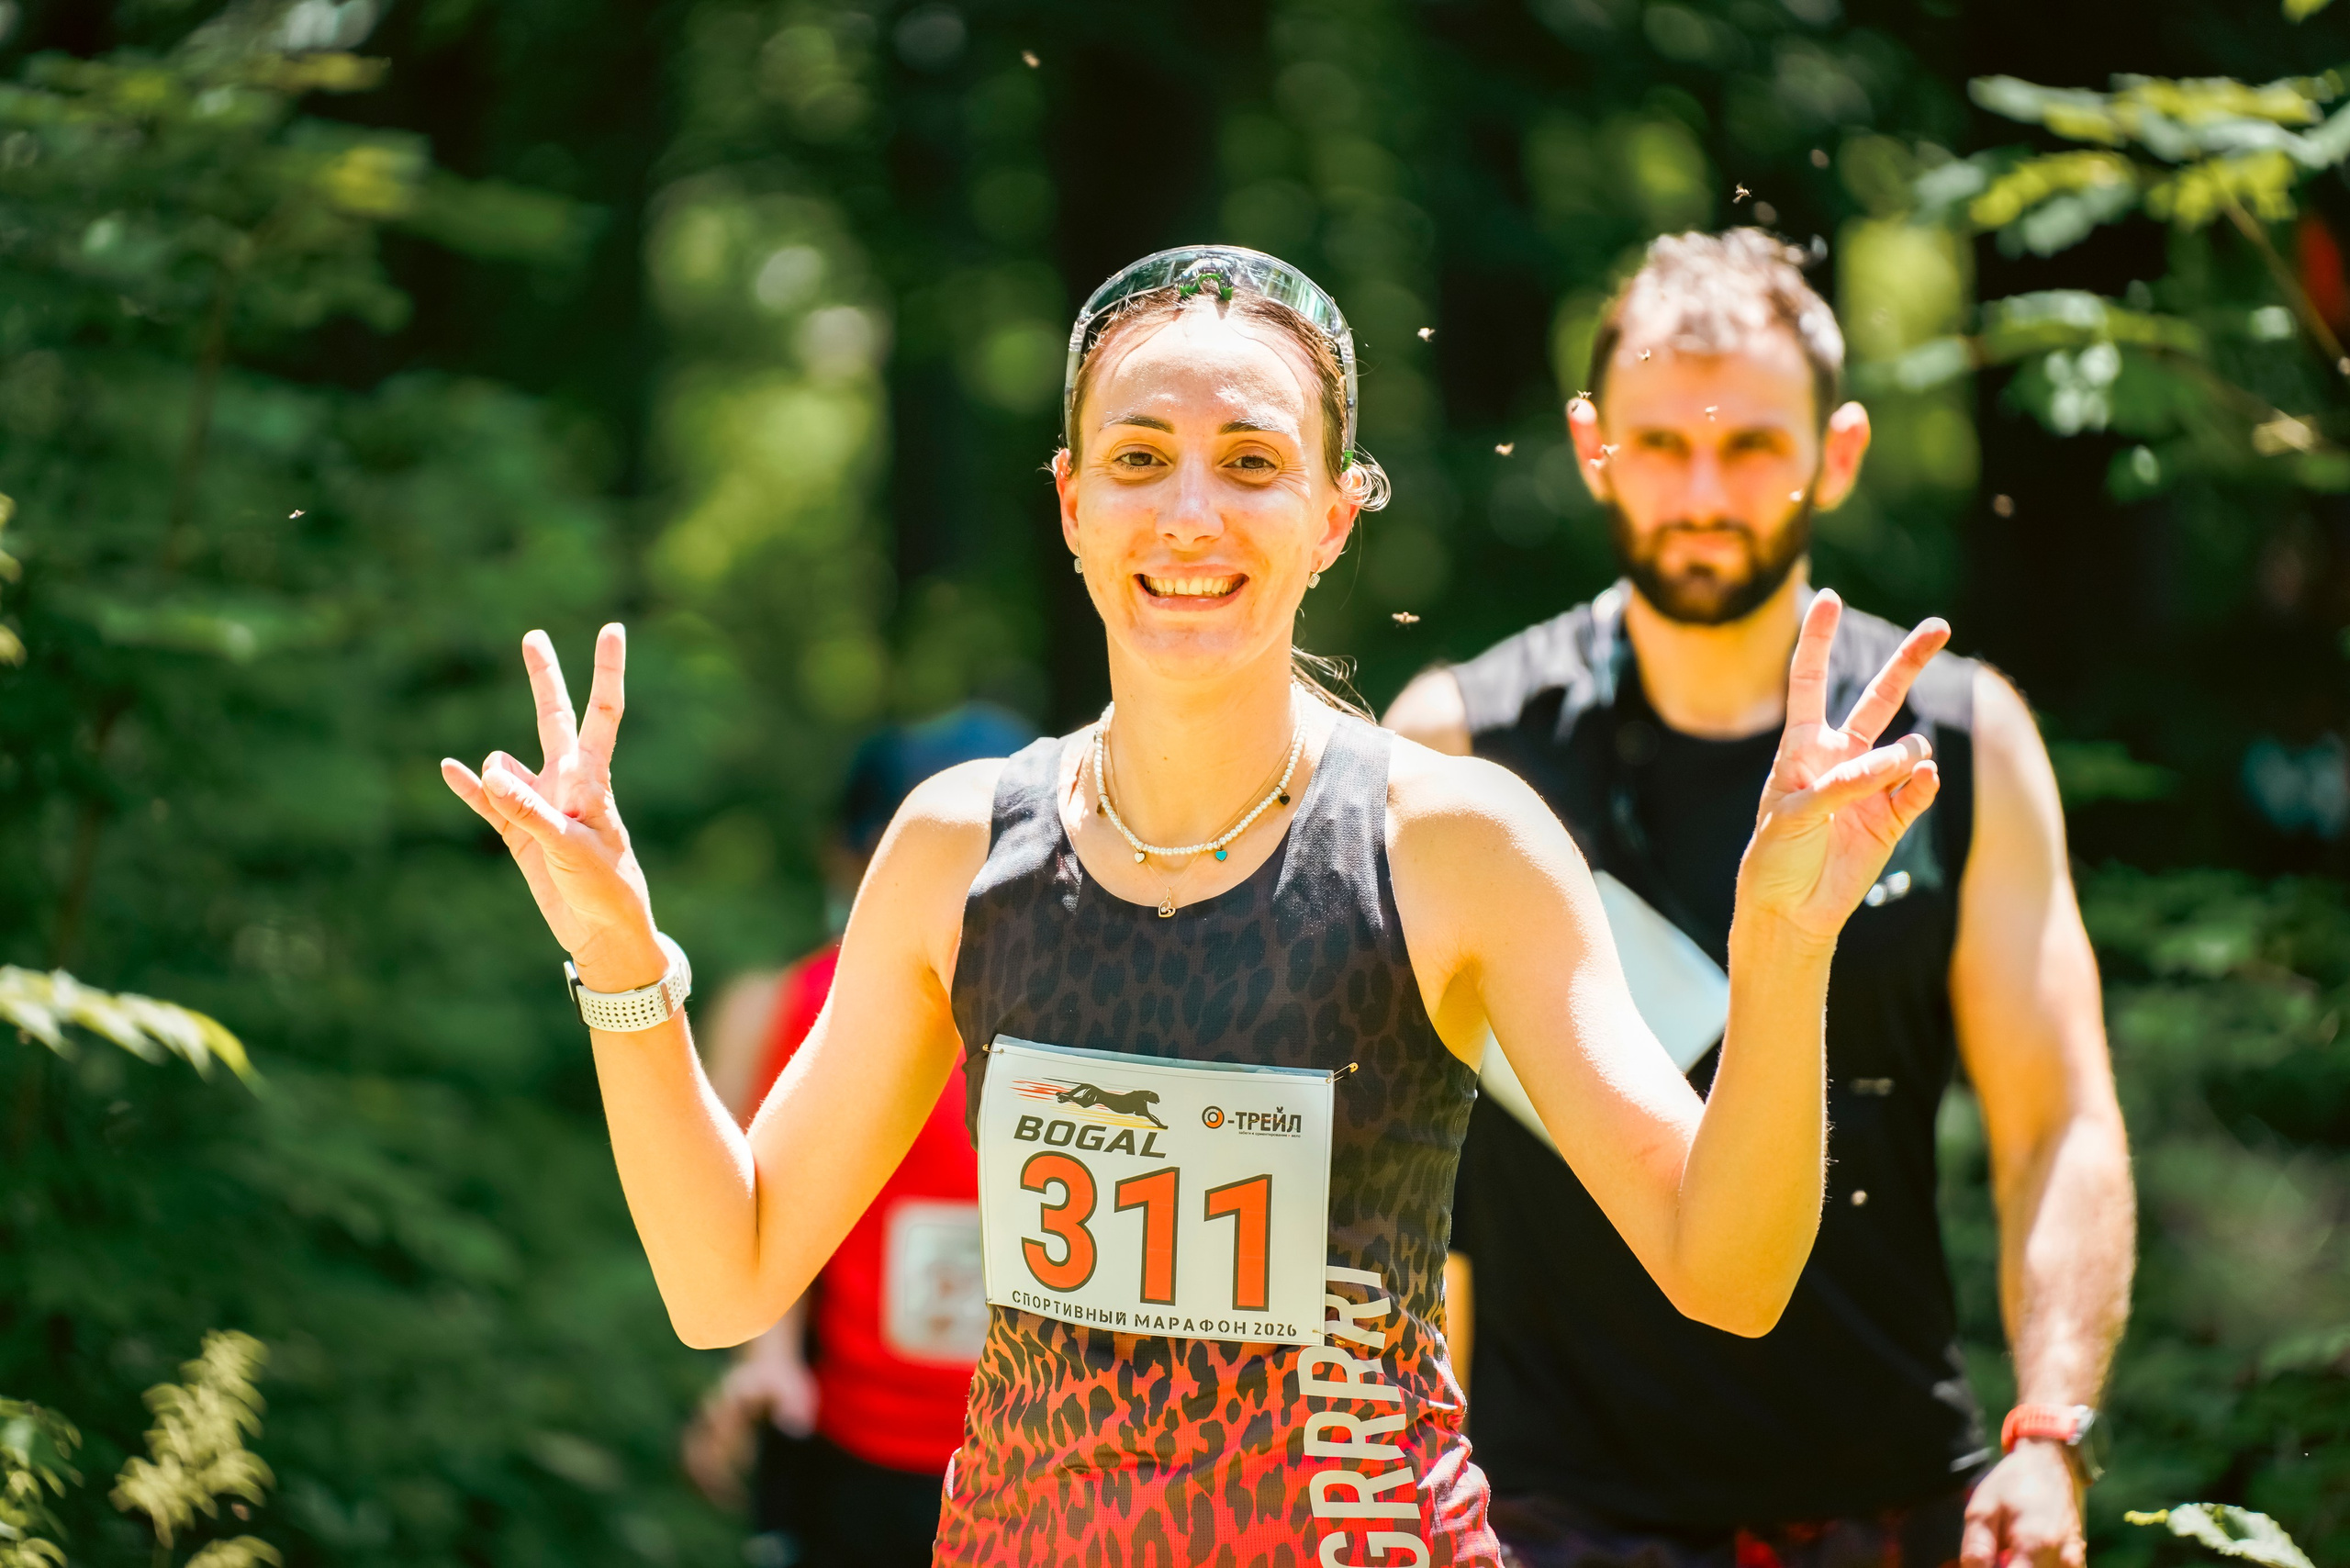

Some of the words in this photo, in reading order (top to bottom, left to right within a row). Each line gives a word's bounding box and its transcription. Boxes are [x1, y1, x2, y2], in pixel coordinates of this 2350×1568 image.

[1013, 1114, 1167, 1159] BOGAL
[1020, 1150, 1273, 1312] 311
[1012, 1290, 1127, 1327] СПОРТИВНЫЙ
[1134, 1314, 1248, 1336] МАРАФОН
[1253, 1322, 1298, 1338] 2026
